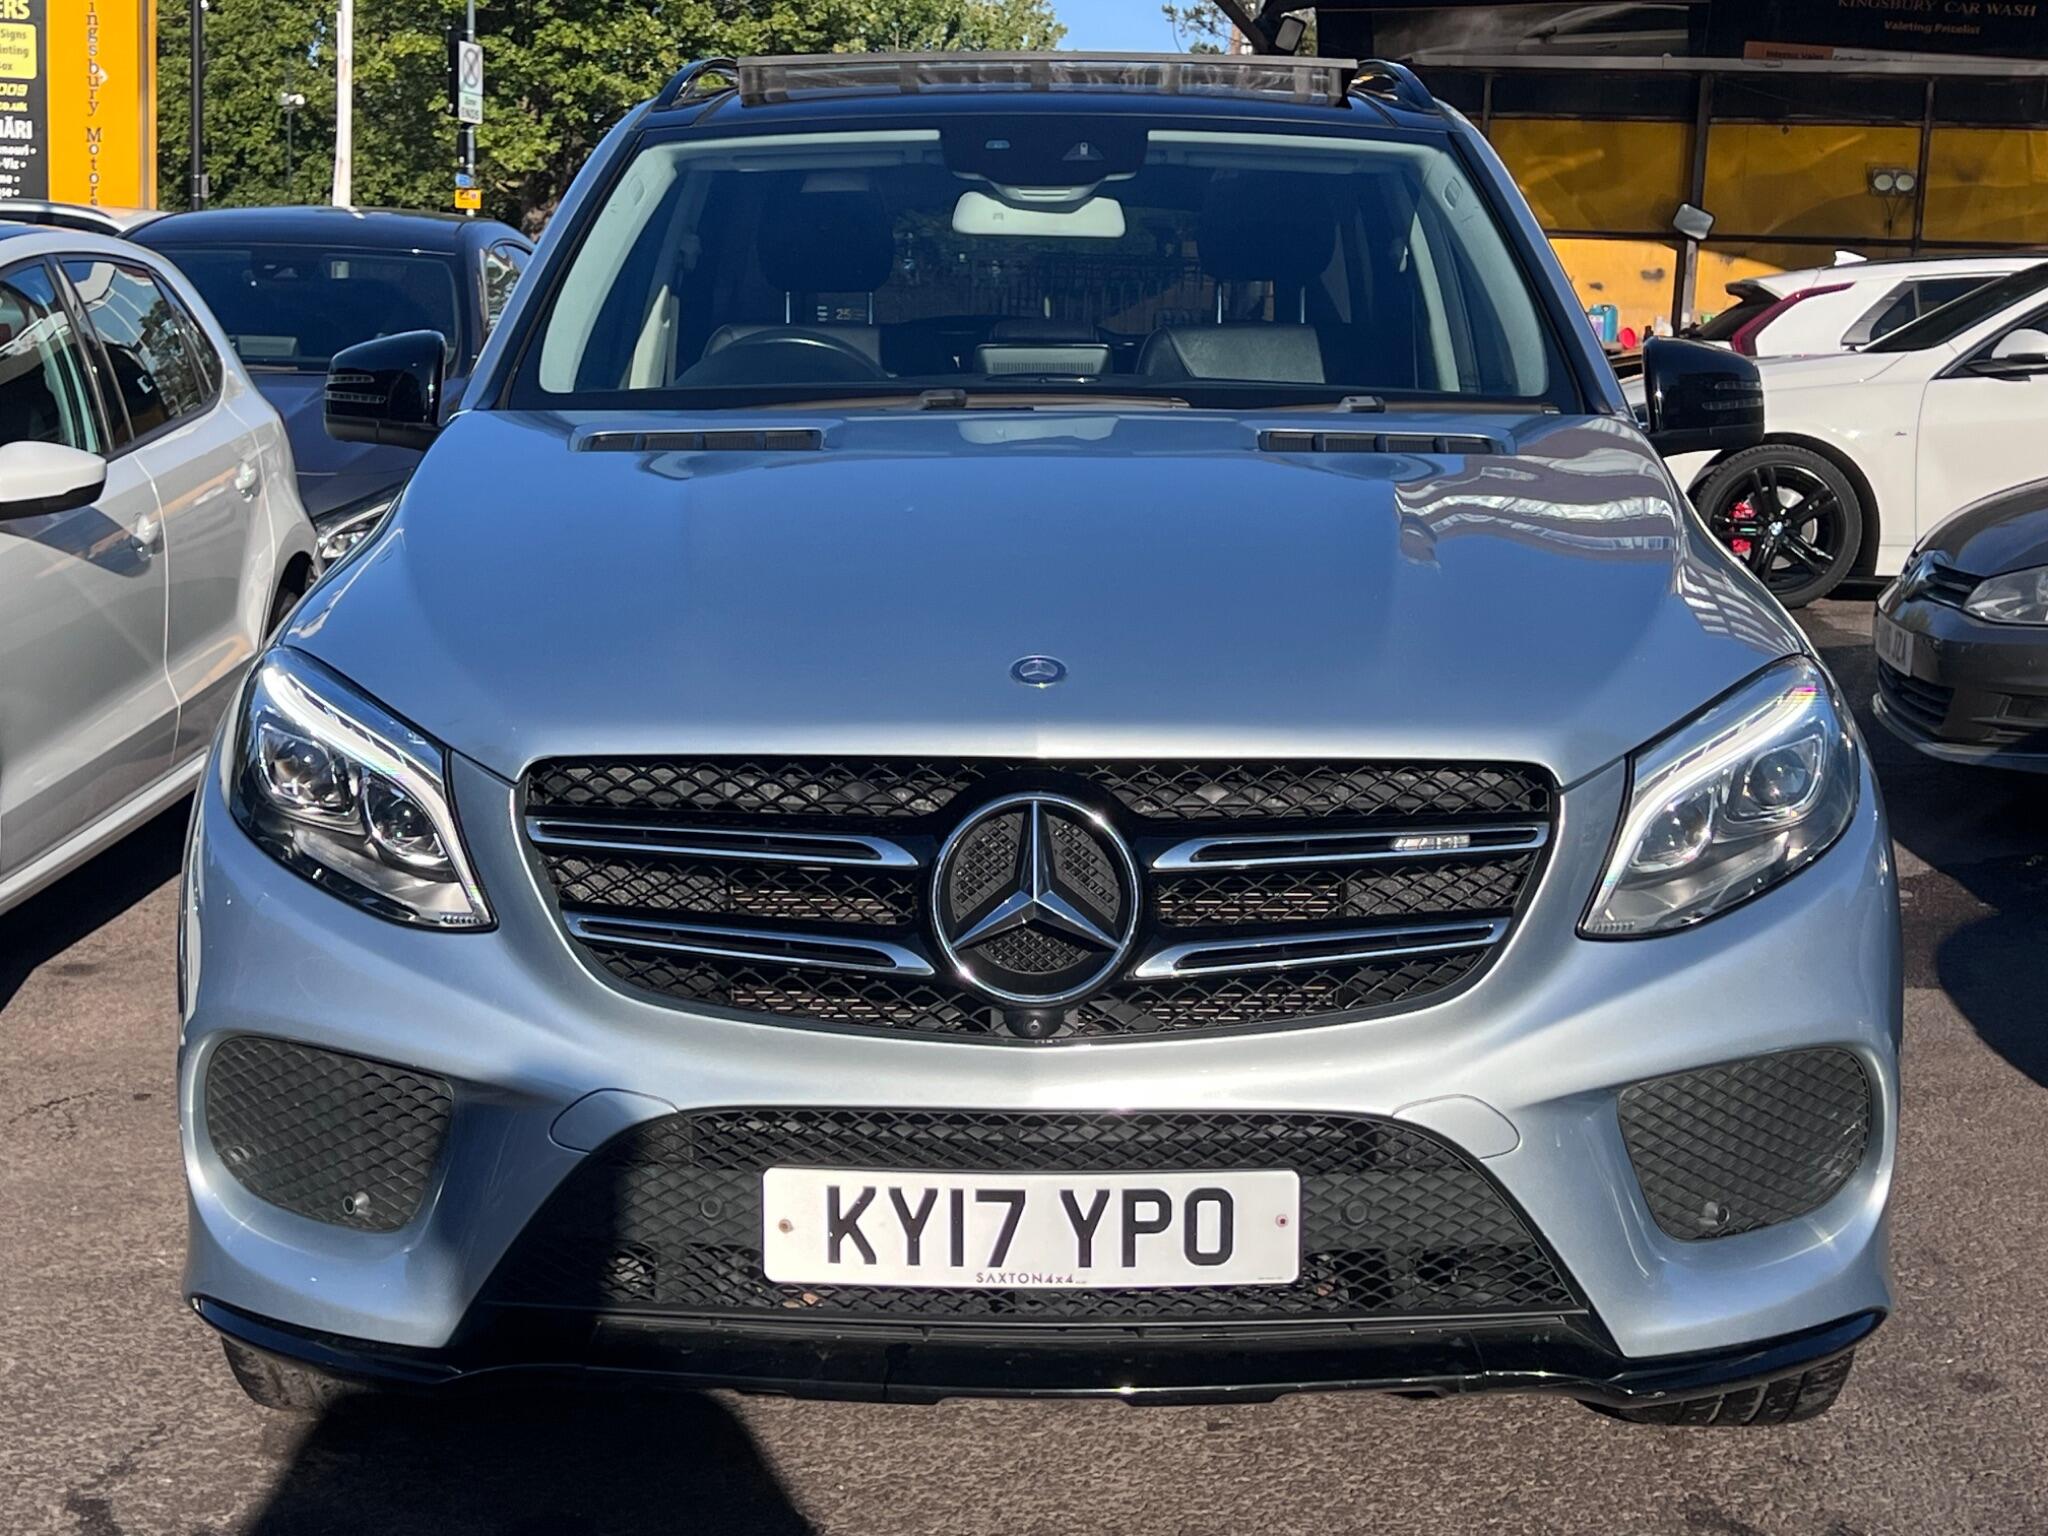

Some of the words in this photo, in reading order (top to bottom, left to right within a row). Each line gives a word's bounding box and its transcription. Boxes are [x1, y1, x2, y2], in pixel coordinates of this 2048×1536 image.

[1944, 2, 1981, 14] CAR
[1987, 4, 2037, 17] WASH
[827, 1185, 1027, 1268] KY17
[1059, 1187, 1235, 1268] YPO
